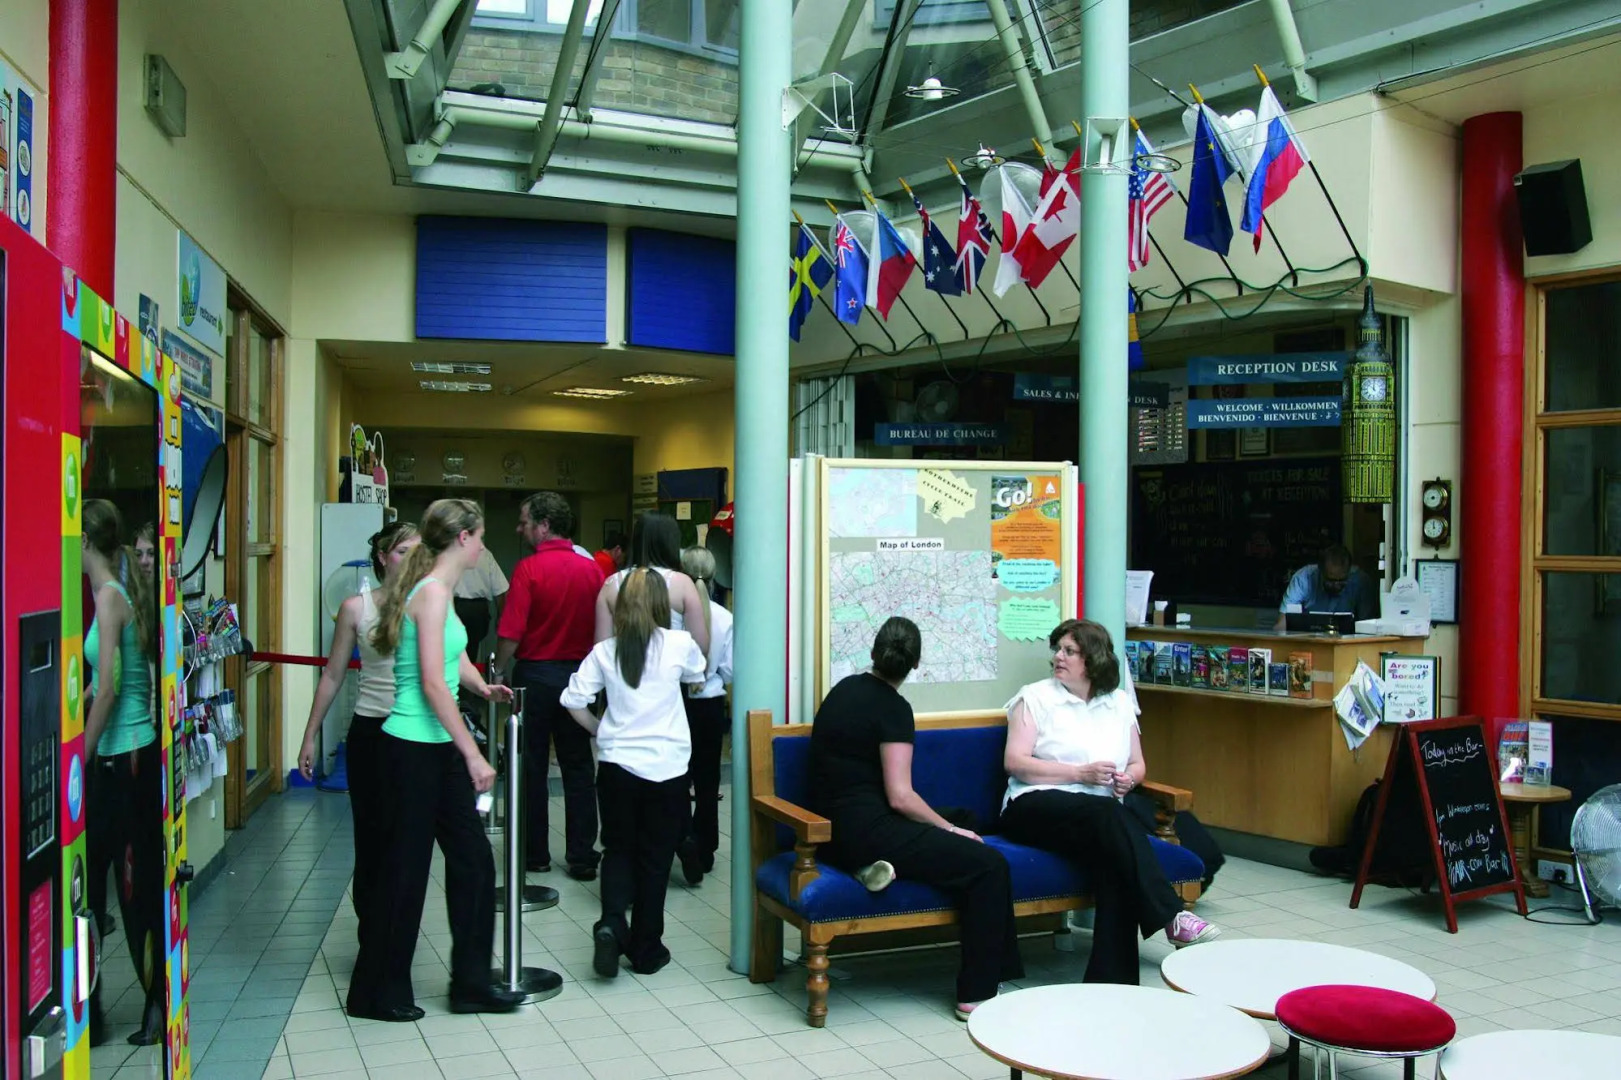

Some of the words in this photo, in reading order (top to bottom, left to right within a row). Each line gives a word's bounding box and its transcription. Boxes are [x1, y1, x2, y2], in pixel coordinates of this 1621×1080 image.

[1218, 362, 1296, 375] RECEPTION
[1302, 360, 1338, 372] DESK
[1023, 389, 1052, 399] SALES
[1055, 391, 1062, 399] &
[1134, 396, 1158, 405] DESK
[1217, 404, 1264, 412] WELCOME
[1272, 402, 1338, 411] WILLKOMMEN
[1198, 414, 1256, 422] BIENVENIDO
[1264, 412, 1317, 422] BIENVENUE
[890, 429, 932, 439] BUREAU
[935, 429, 950, 438] DE
[953, 429, 998, 438] CHANGE
[376, 488, 388, 505] SHOP
[996, 482, 1033, 508] Go!
[880, 542, 898, 550] Map
[1420, 740, 1446, 766] Today
[1454, 743, 1464, 754] the
[1443, 839, 1463, 857] Music
[1465, 833, 1474, 848] all
[1476, 829, 1490, 852] day
[1485, 854, 1500, 874] Bar
